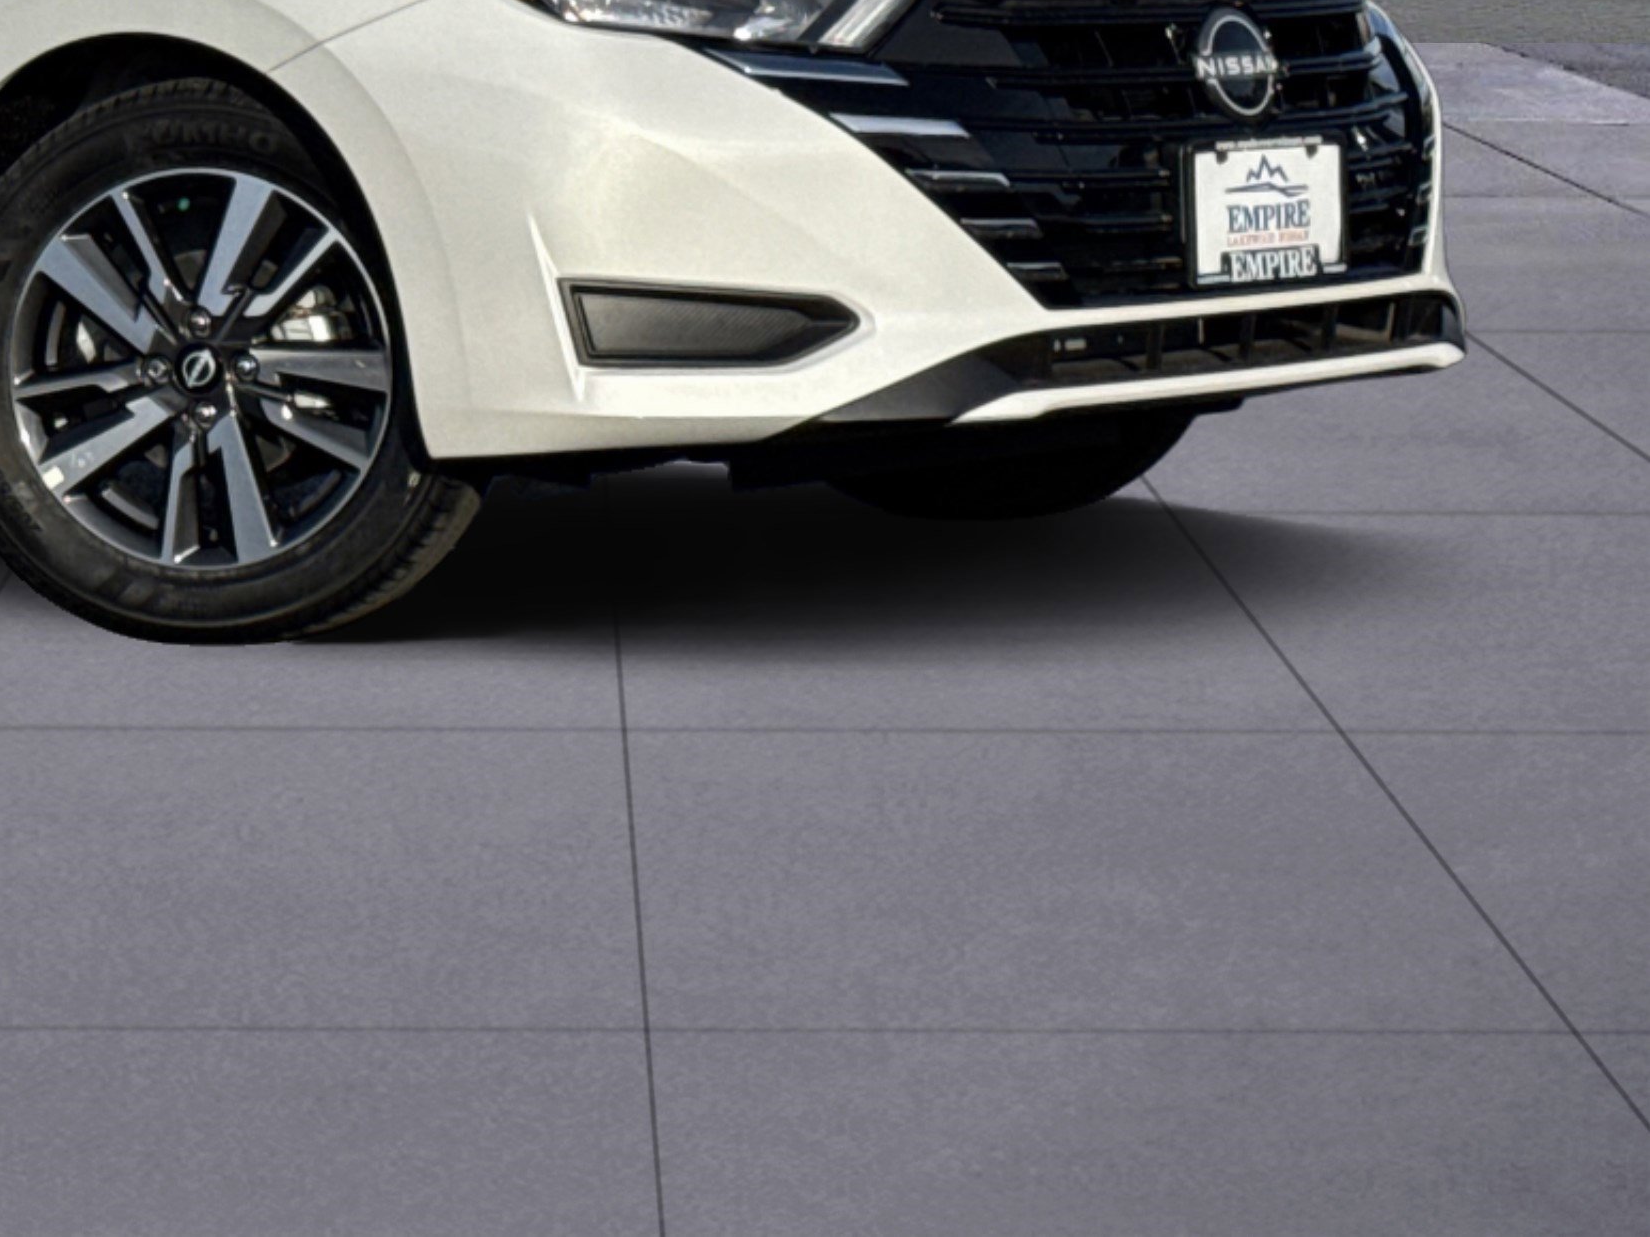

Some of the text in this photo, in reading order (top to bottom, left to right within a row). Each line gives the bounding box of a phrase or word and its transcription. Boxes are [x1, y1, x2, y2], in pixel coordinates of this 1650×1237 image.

[1197, 55, 1278, 79] NISSAN
[1226, 199, 1311, 232] EMPIRE
[1229, 247, 1318, 282] EMPIRE
